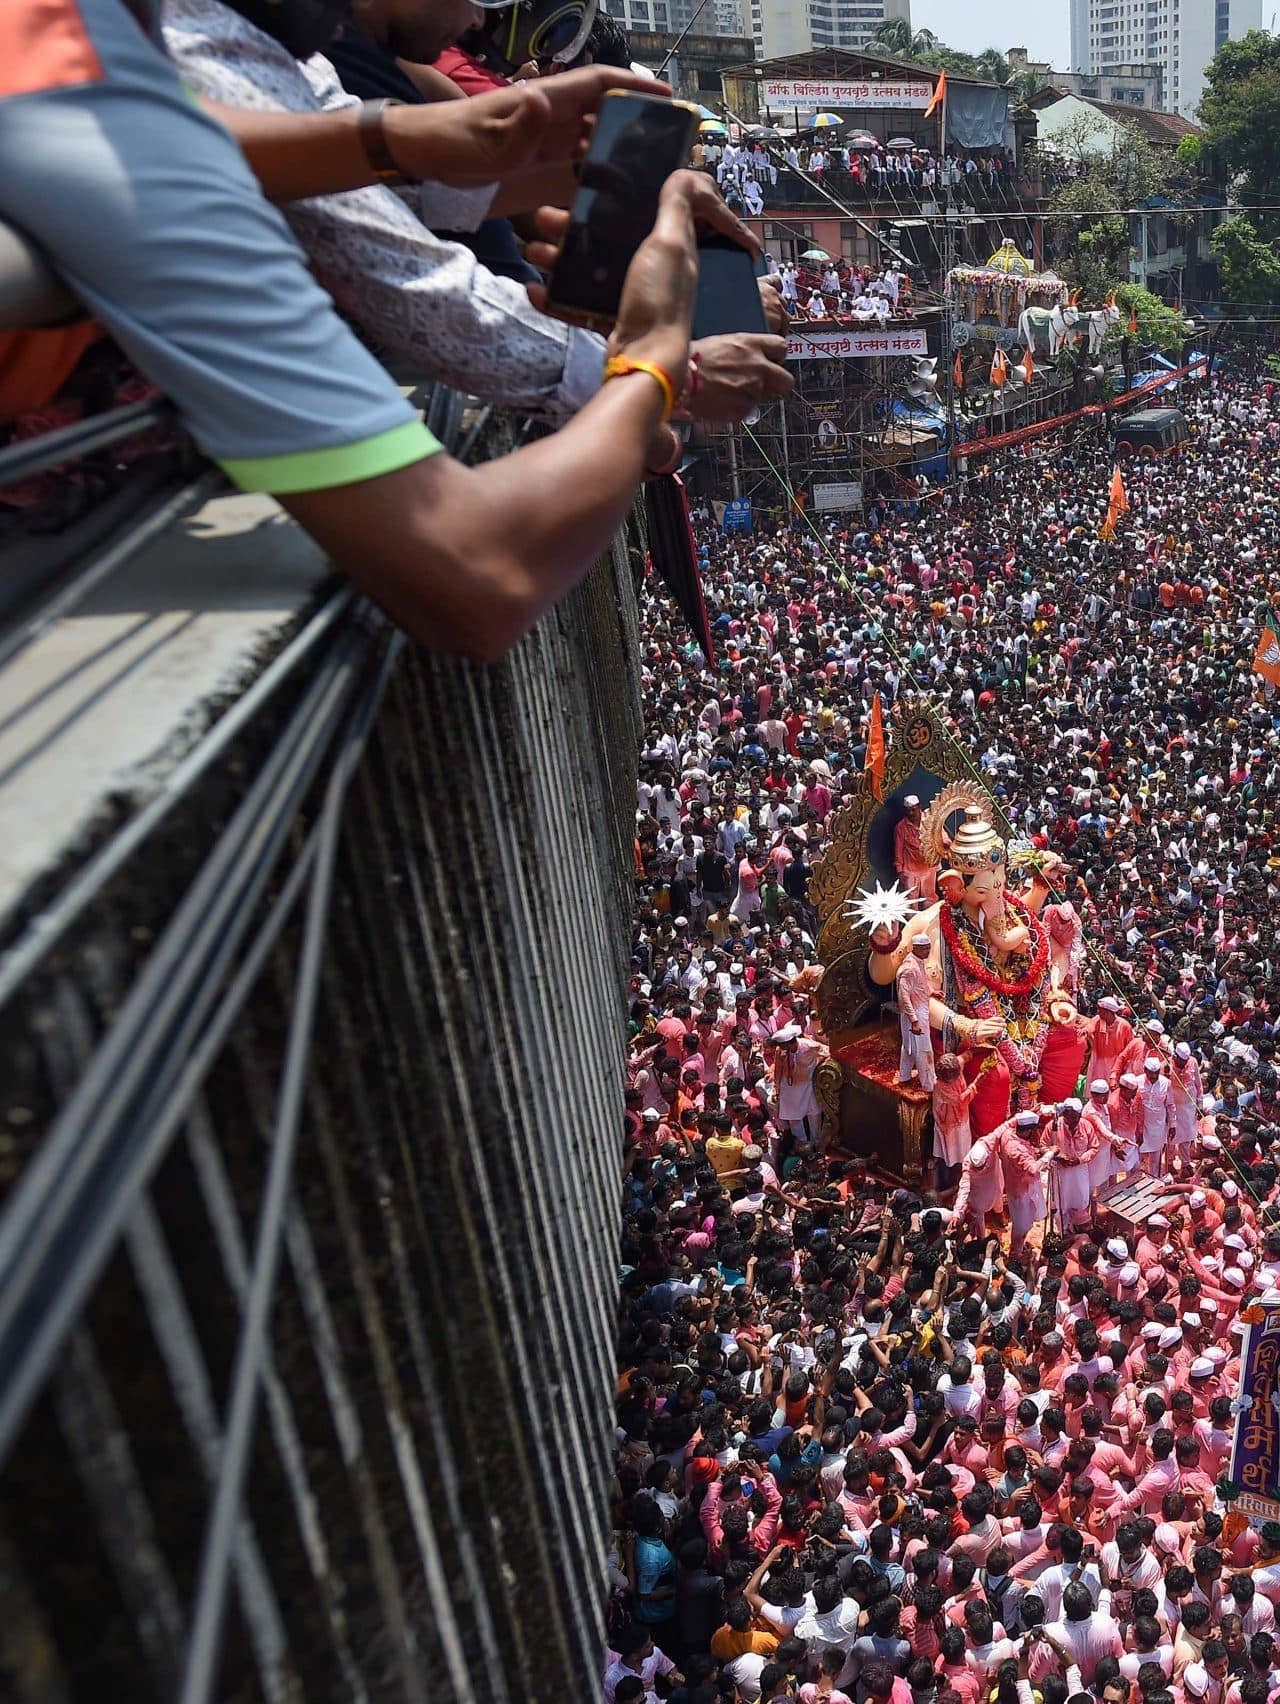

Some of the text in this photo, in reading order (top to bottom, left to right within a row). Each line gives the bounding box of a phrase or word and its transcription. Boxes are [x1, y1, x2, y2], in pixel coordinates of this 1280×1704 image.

[872, 85, 900, 97] उत्सव
[904, 85, 929, 97] मंडळ
[855, 339, 888, 351] उत्सव
[892, 336, 921, 350] मंडळ
